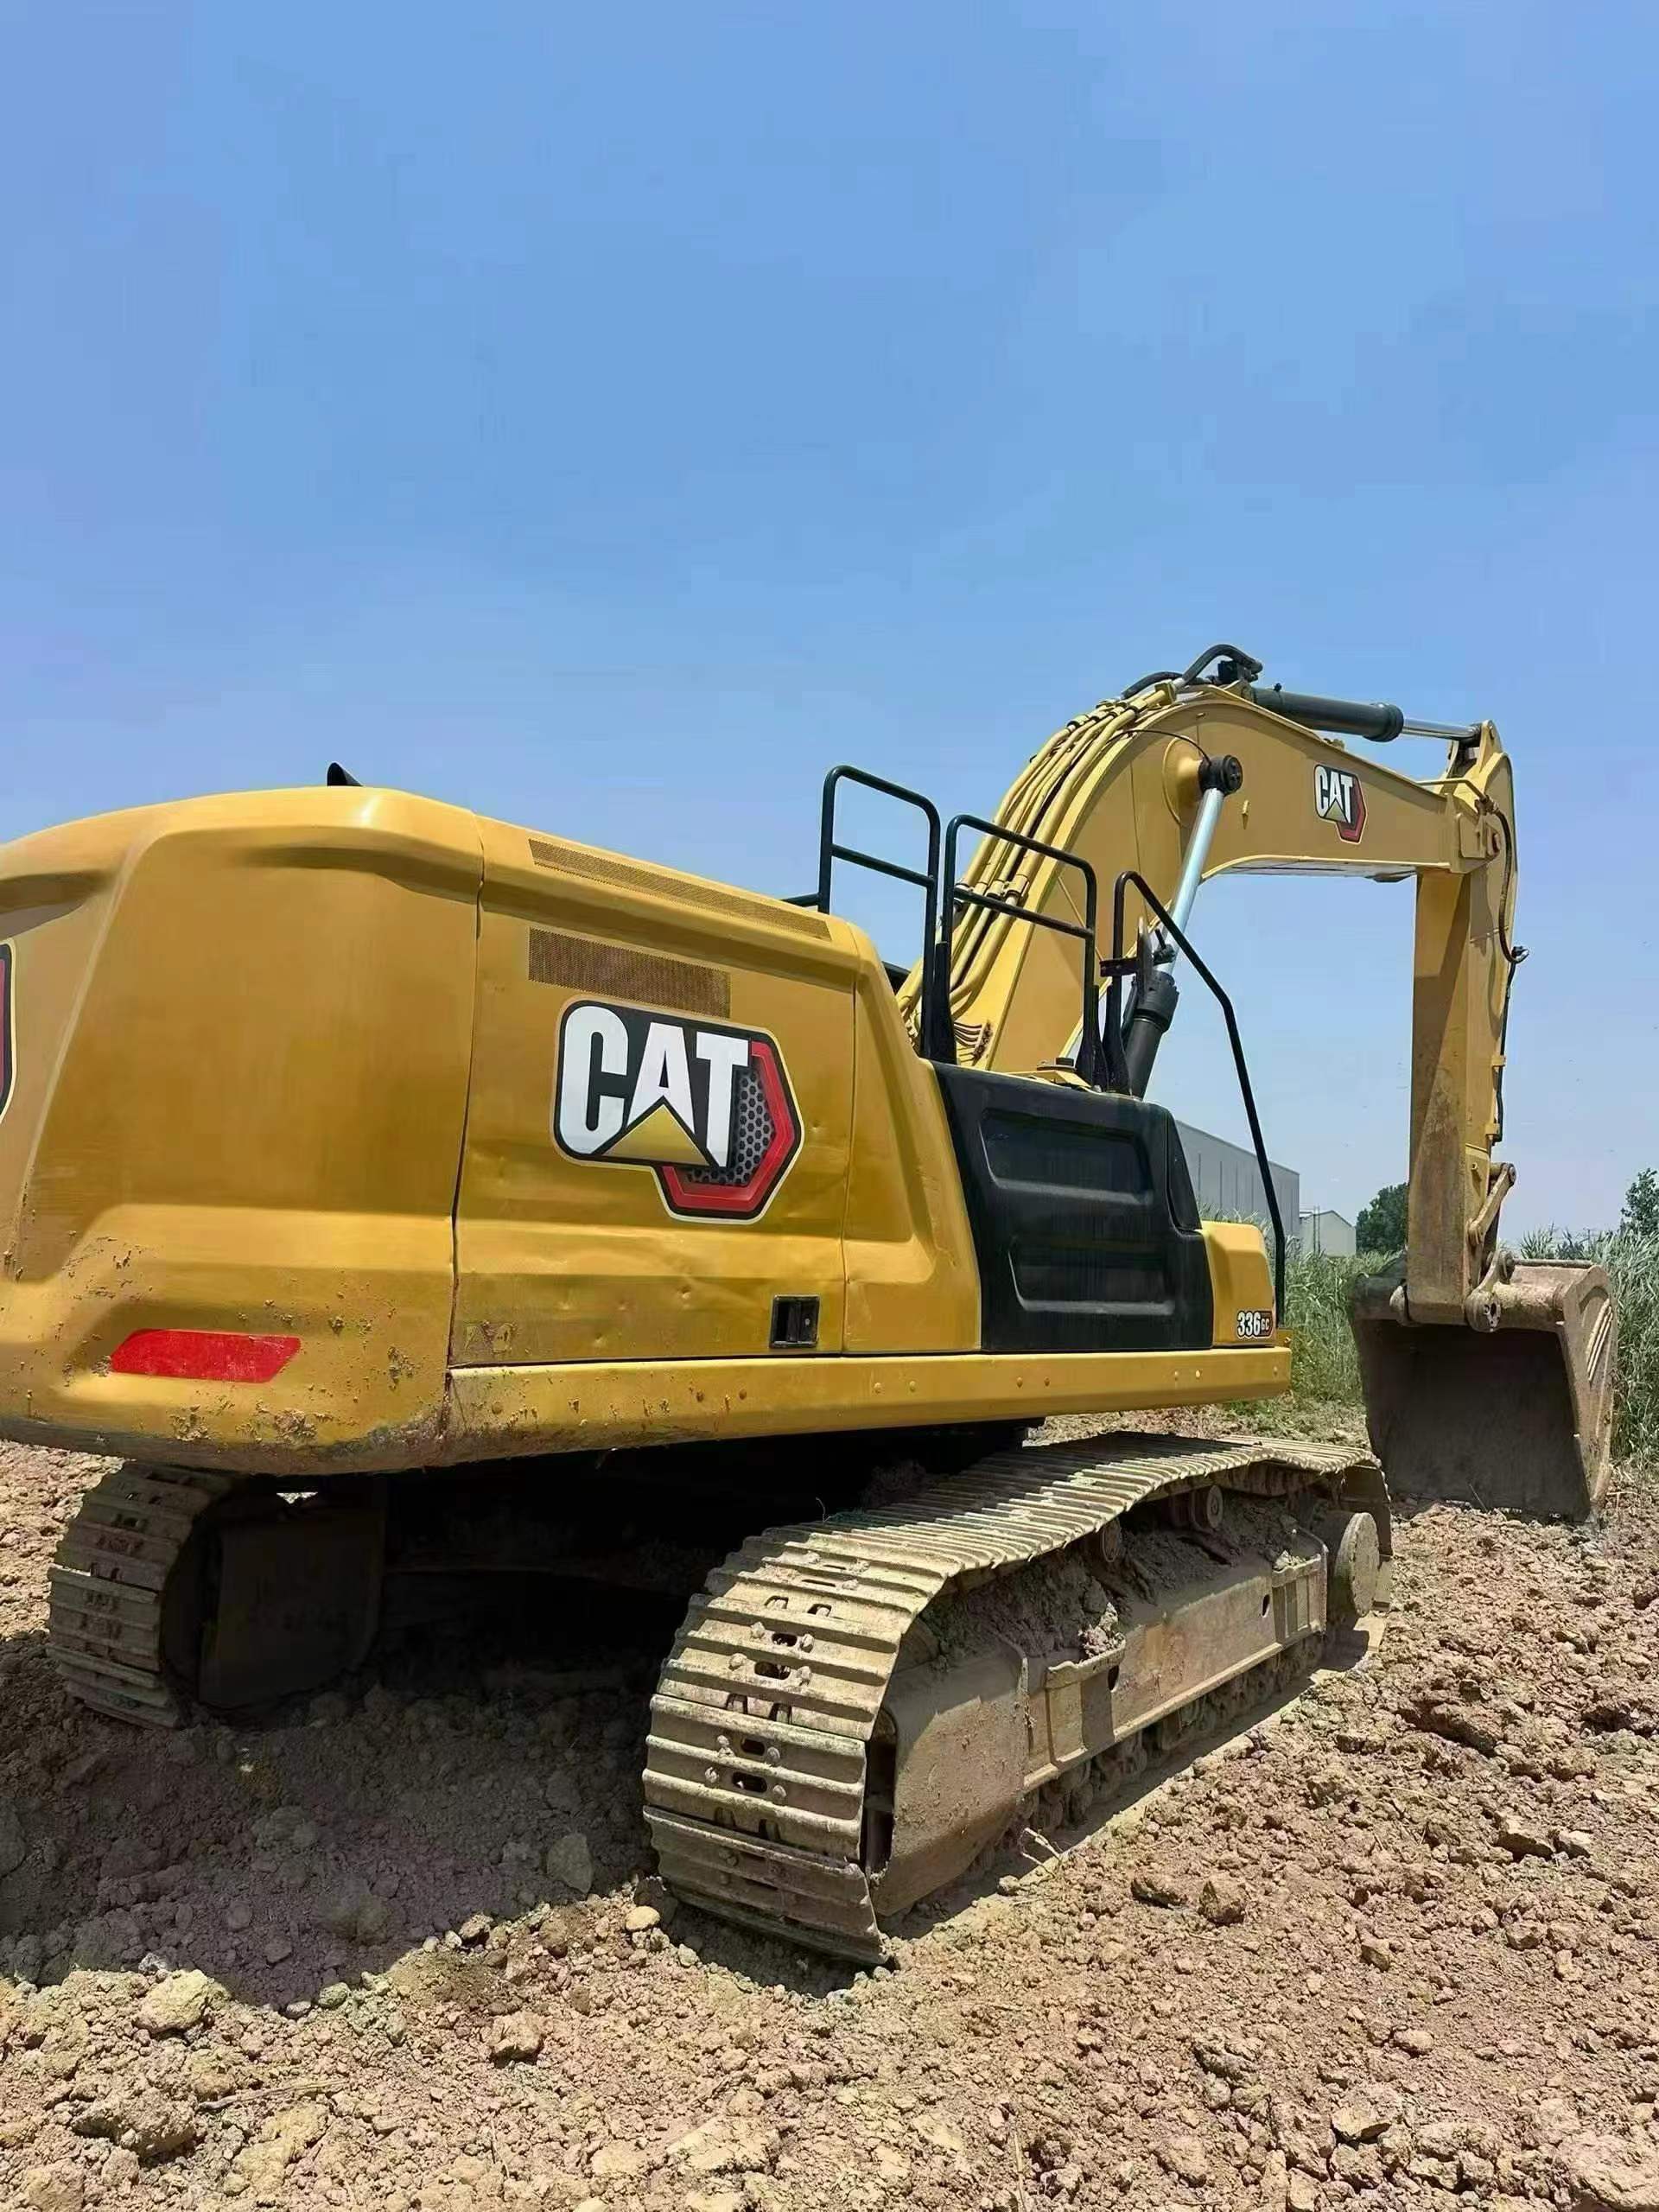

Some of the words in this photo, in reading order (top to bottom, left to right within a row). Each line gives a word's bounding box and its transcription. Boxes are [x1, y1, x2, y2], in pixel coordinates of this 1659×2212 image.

[1314, 766, 1353, 823] CAT
[559, 1005, 749, 1167] CAT
[1237, 1312, 1261, 1336] 336
